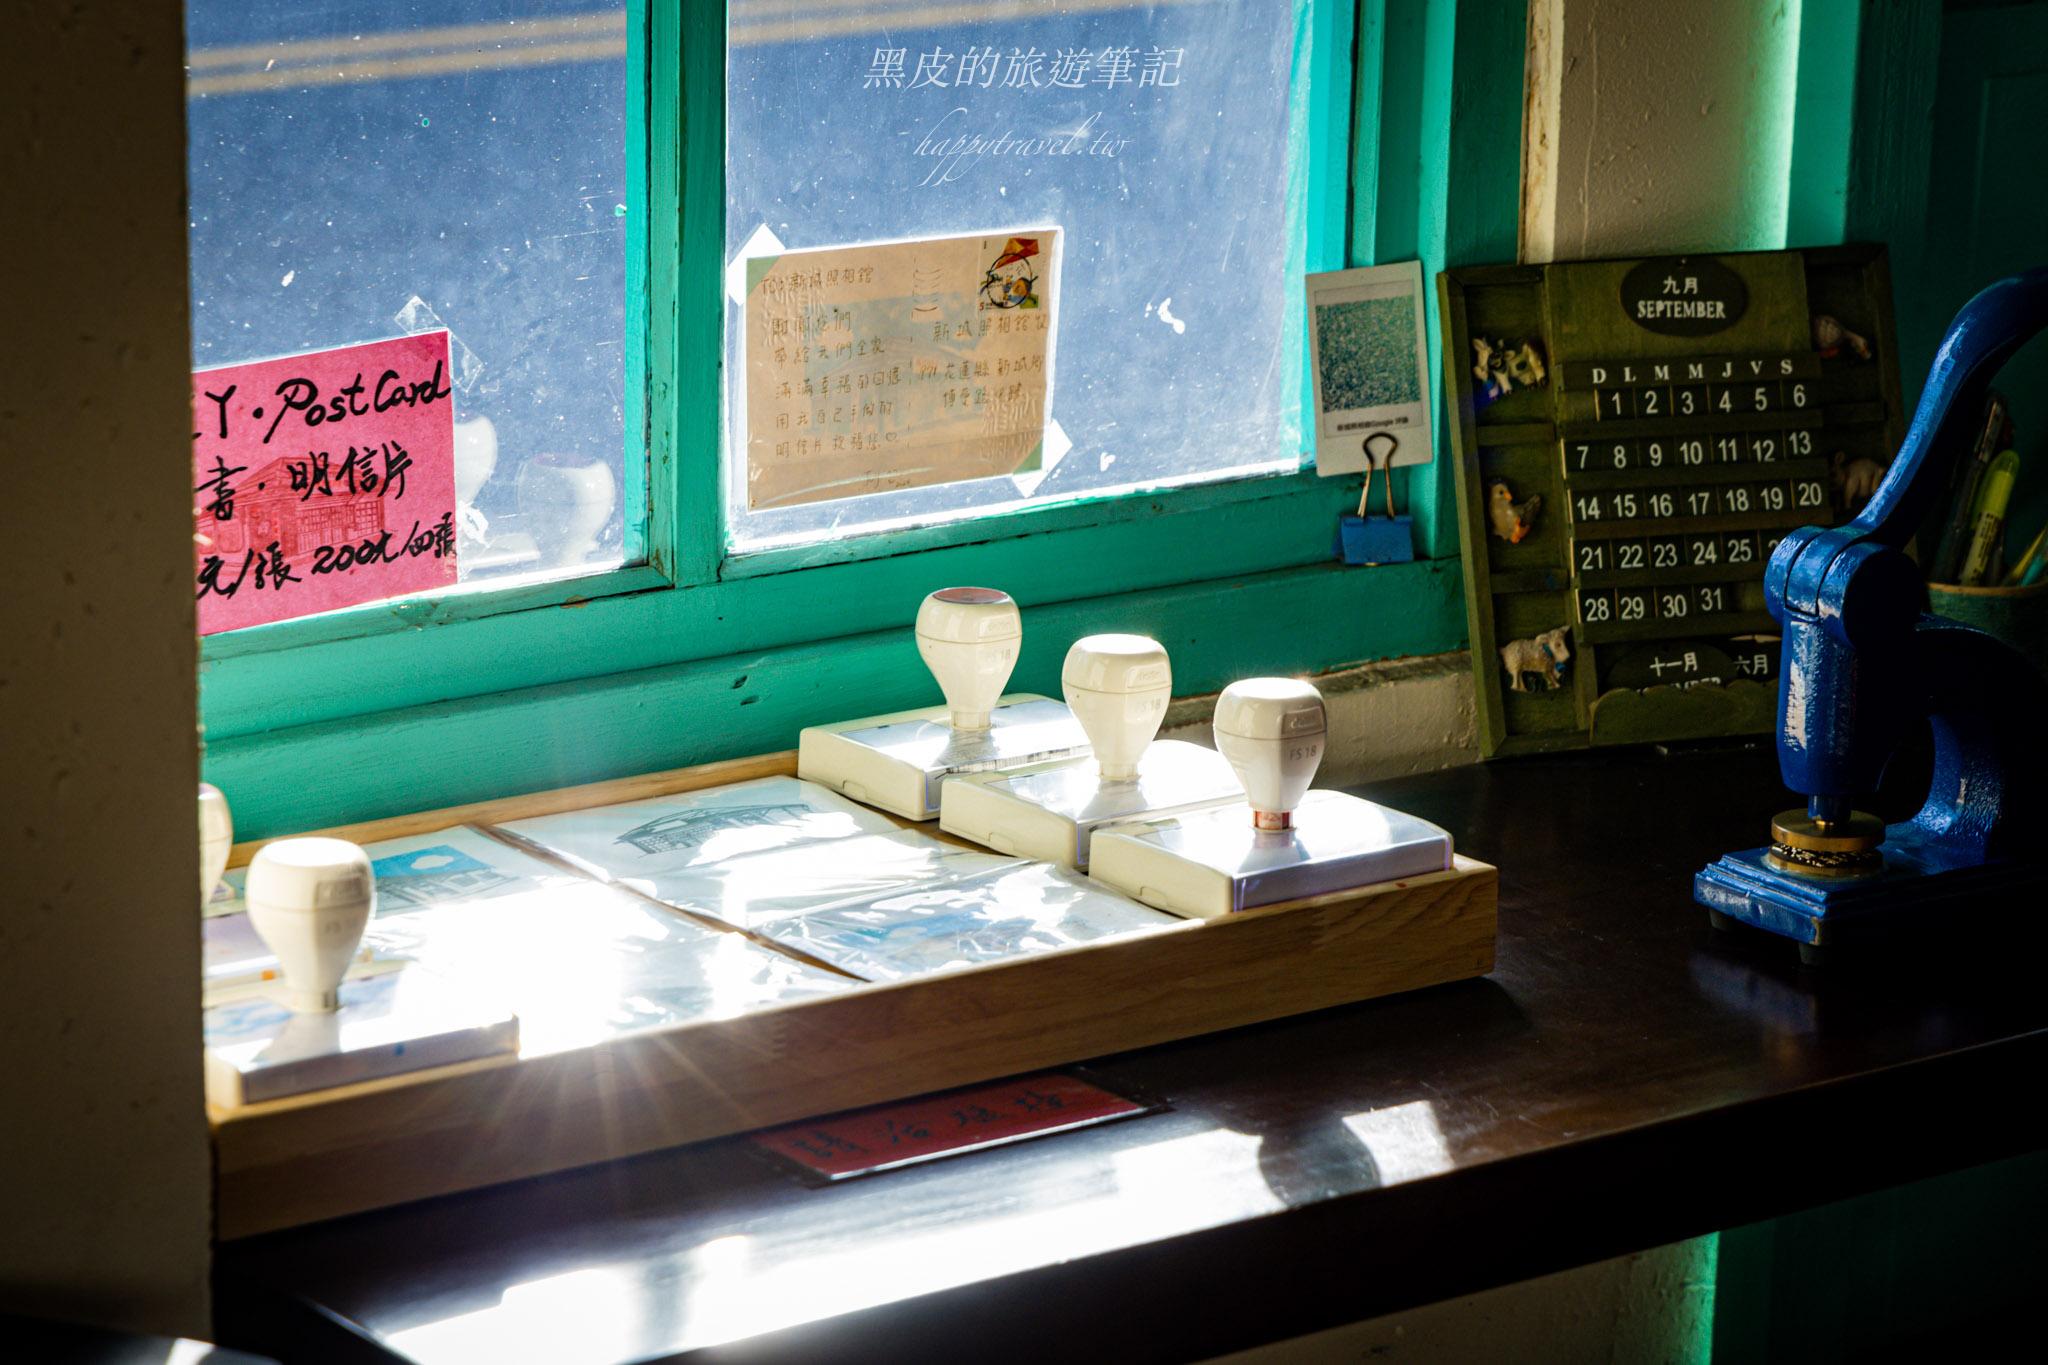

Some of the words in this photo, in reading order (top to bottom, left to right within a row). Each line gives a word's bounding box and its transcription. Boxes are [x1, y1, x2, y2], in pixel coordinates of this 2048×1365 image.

[1662, 276, 1698, 295] 九月
[1637, 300, 1726, 319] SEPTEMBER
[1592, 367, 1607, 385] D
[1623, 365, 1638, 383] L
[1654, 364, 1670, 381] M
[1688, 363, 1704, 379] M
[1721, 361, 1733, 378] J
[1750, 360, 1763, 375] V
[1780, 359, 1794, 375] S
[1611, 391, 1622, 416] 1
[1644, 390, 1659, 415] 2
[1681, 391, 1694, 415] 3
[1718, 390, 1732, 413] 4
[1755, 387, 1768, 411] 5
[1792, 383, 1806, 408] 6
[1576, 445, 1589, 469] 7
[1613, 445, 1627, 469] 8
[1649, 443, 1662, 467] 9
[1679, 441, 1703, 465] 10
[1717, 438, 1737, 461] 11
[1752, 439, 1776, 462] 12
[1788, 431, 1812, 455] 13
[1576, 496, 1601, 521] 14
[1612, 494, 1637, 518] 15
[1649, 493, 1673, 517] 16
[1687, 492, 1710, 516] 17
[1725, 488, 1749, 512] 18
[1760, 487, 1784, 510] 19
[1797, 482, 1822, 506] 20
[1581, 546, 1603, 571] 21
[1618, 544, 1645, 569] 22
[1653, 543, 1678, 568] 23
[1692, 541, 1718, 565] 24
[1727, 538, 1752, 563] 25
[1584, 597, 1610, 622] 28
[1620, 596, 1645, 621] 29
[1661, 594, 1687, 618] 30
[1700, 588, 1723, 612] 31
[1649, 651, 1698, 677] 十一月
